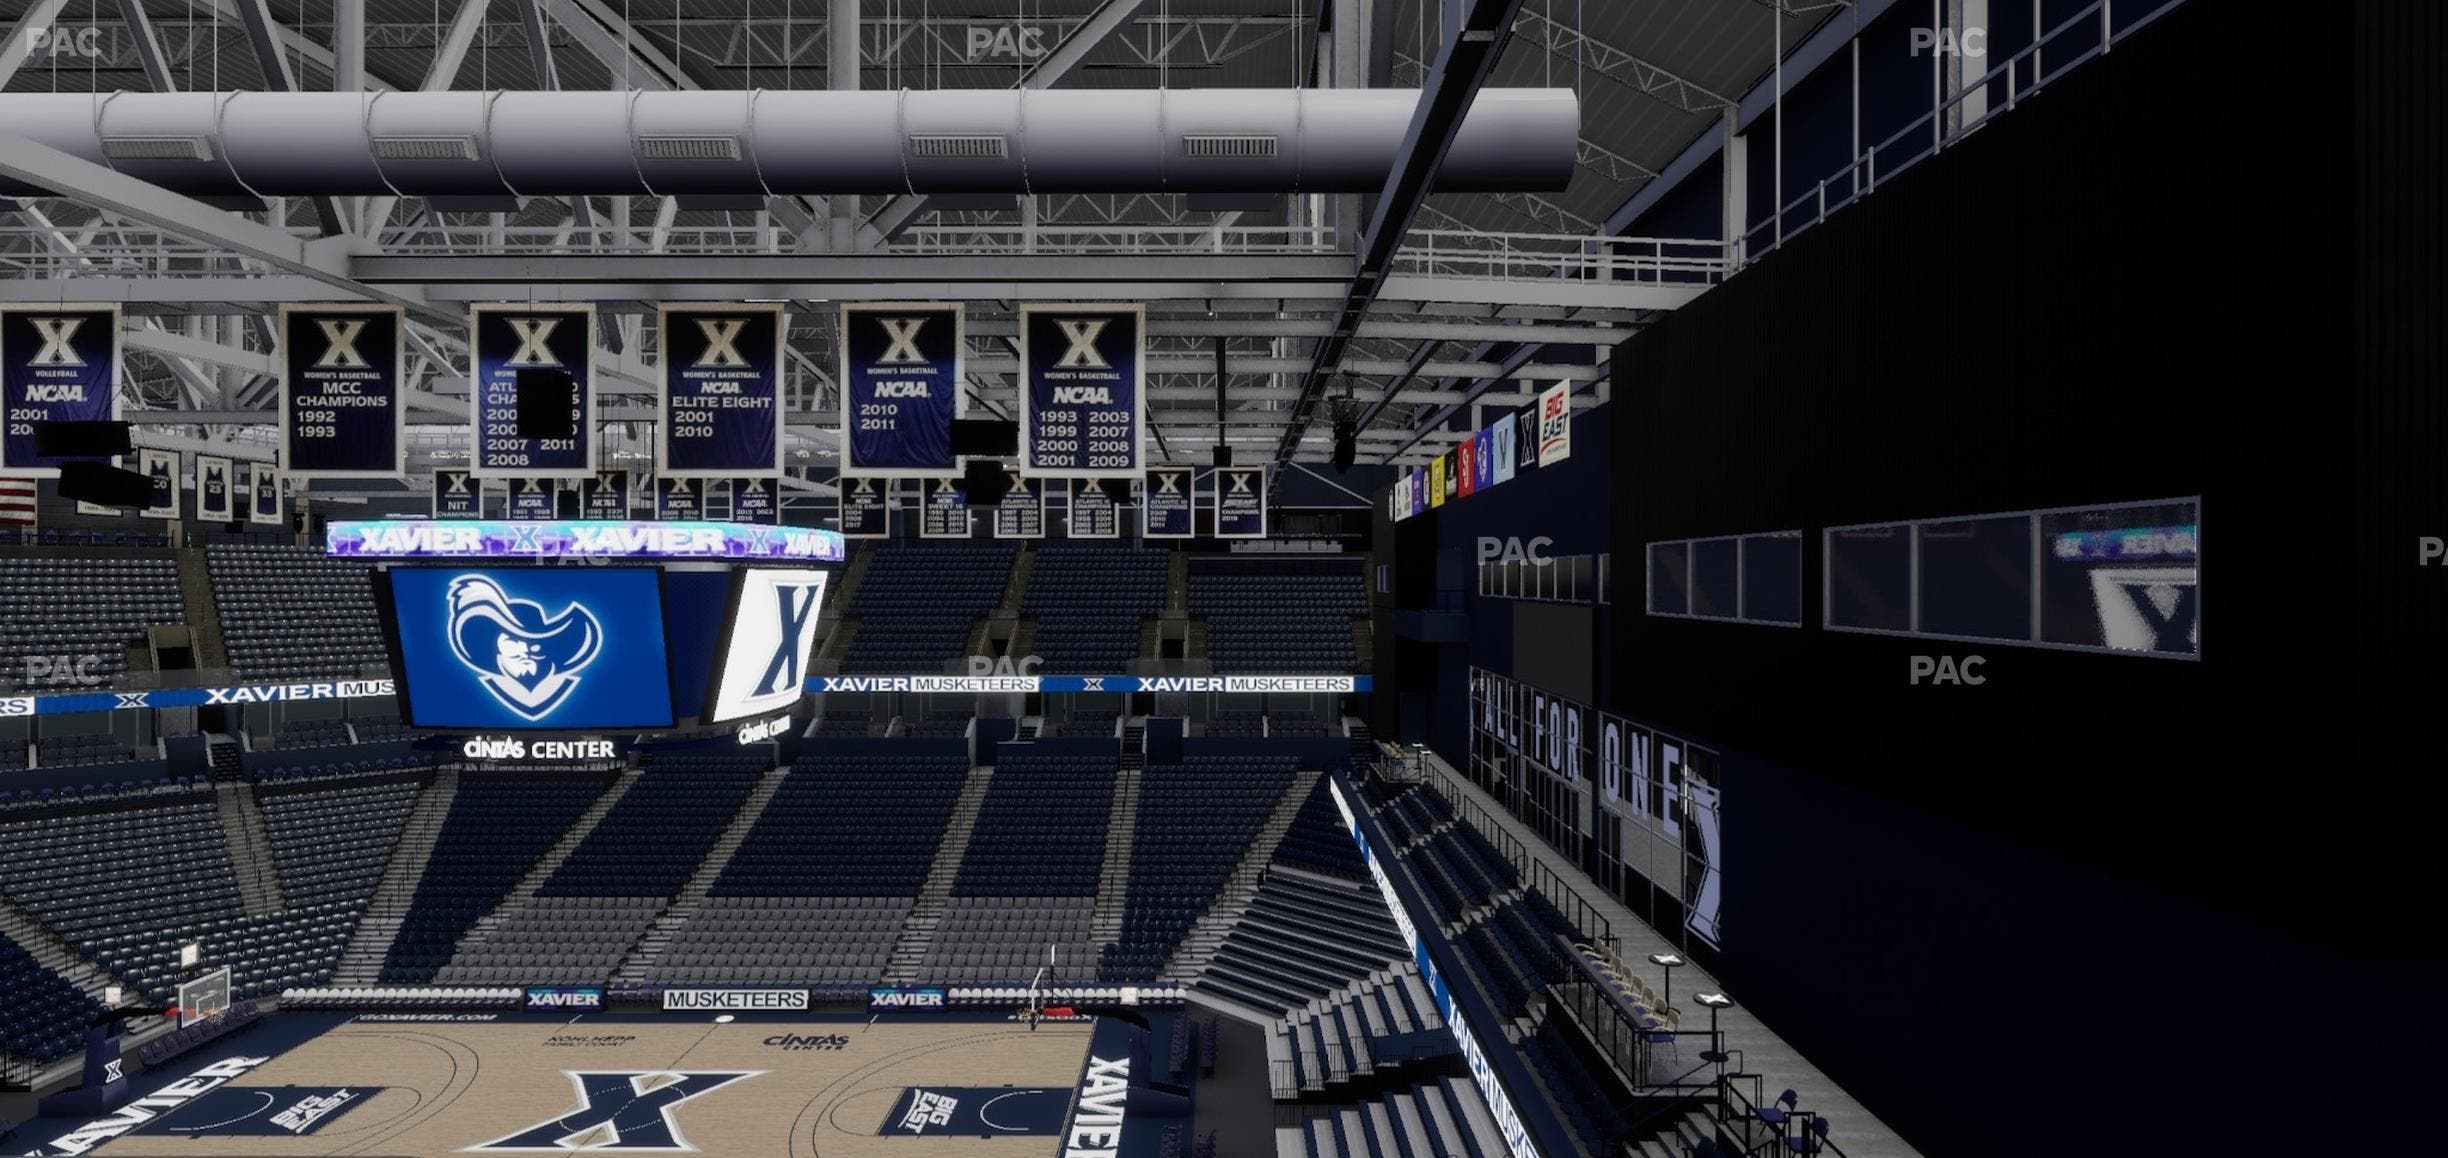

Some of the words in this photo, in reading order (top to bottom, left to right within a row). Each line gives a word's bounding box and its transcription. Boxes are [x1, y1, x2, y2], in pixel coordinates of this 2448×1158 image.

[26, 317, 88, 367] X
[313, 319, 372, 368] X
[503, 318, 564, 367] X
[691, 318, 752, 368] X
[875, 317, 931, 364] X
[1052, 318, 1113, 369] X
[25, 385, 85, 402] NCAA
[322, 382, 362, 395] MCC
[701, 381, 740, 394] NCAA
[874, 381, 929, 398] NCAA
[296, 396, 388, 408] CHAMPIONS
[672, 396, 719, 408] ELITE
[722, 397, 772, 408] EIGHT
[1053, 386, 1110, 404] NCAA
[860, 404, 898, 416] 2010
[1544, 391, 1564, 421] BIG
[10, 408, 49, 420] 2001
[297, 410, 336, 423] 1992
[487, 410, 517, 421] 200
[675, 411, 713, 423] 2001
[1039, 411, 1078, 423] 1993
[1089, 411, 1129, 423] 2003
[487, 424, 517, 436] 200
[861, 418, 895, 430] 2011
[1542, 412, 1569, 441] EAST
[297, 425, 336, 438] 1993
[675, 426, 713, 437] 2010
[1039, 426, 1077, 437] 1999
[1089, 426, 1129, 437] 2007
[487, 439, 527, 451] 2007
[540, 439, 575, 450] 2011
[1037, 440, 1078, 452] 2000
[1088, 441, 1129, 453] 2008
[487, 454, 529, 466] 2008
[1037, 455, 1076, 467] 2001
[1088, 455, 1129, 467] 2009
[448, 501, 468, 510] NIT
[359, 527, 483, 551] XAVIER
[571, 527, 727, 552] XAVIER
[784, 532, 830, 556] XAVIER
[823, 677, 909, 692] XAVIER
[915, 678, 1036, 691] MUSKETEERS
[1137, 677, 1225, 692] XAVIER
[1230, 678, 1350, 691] MUSKETEERS
[204, 684, 333, 705] XAVIER
[531, 741, 616, 759] CENTER
[1484, 677, 1518, 747] ALL
[1535, 695, 1580, 783] FOR
[1604, 722, 1681, 839] ONE
[526, 993, 600, 1006] XAVIER
[667, 991, 806, 1008] MUSKETEERS
[871, 992, 943, 1006] XAVIER
[22, 1055, 270, 1158] AVIER
[905, 1091, 940, 1134] EAST
[928, 1095, 958, 1127] BIG
